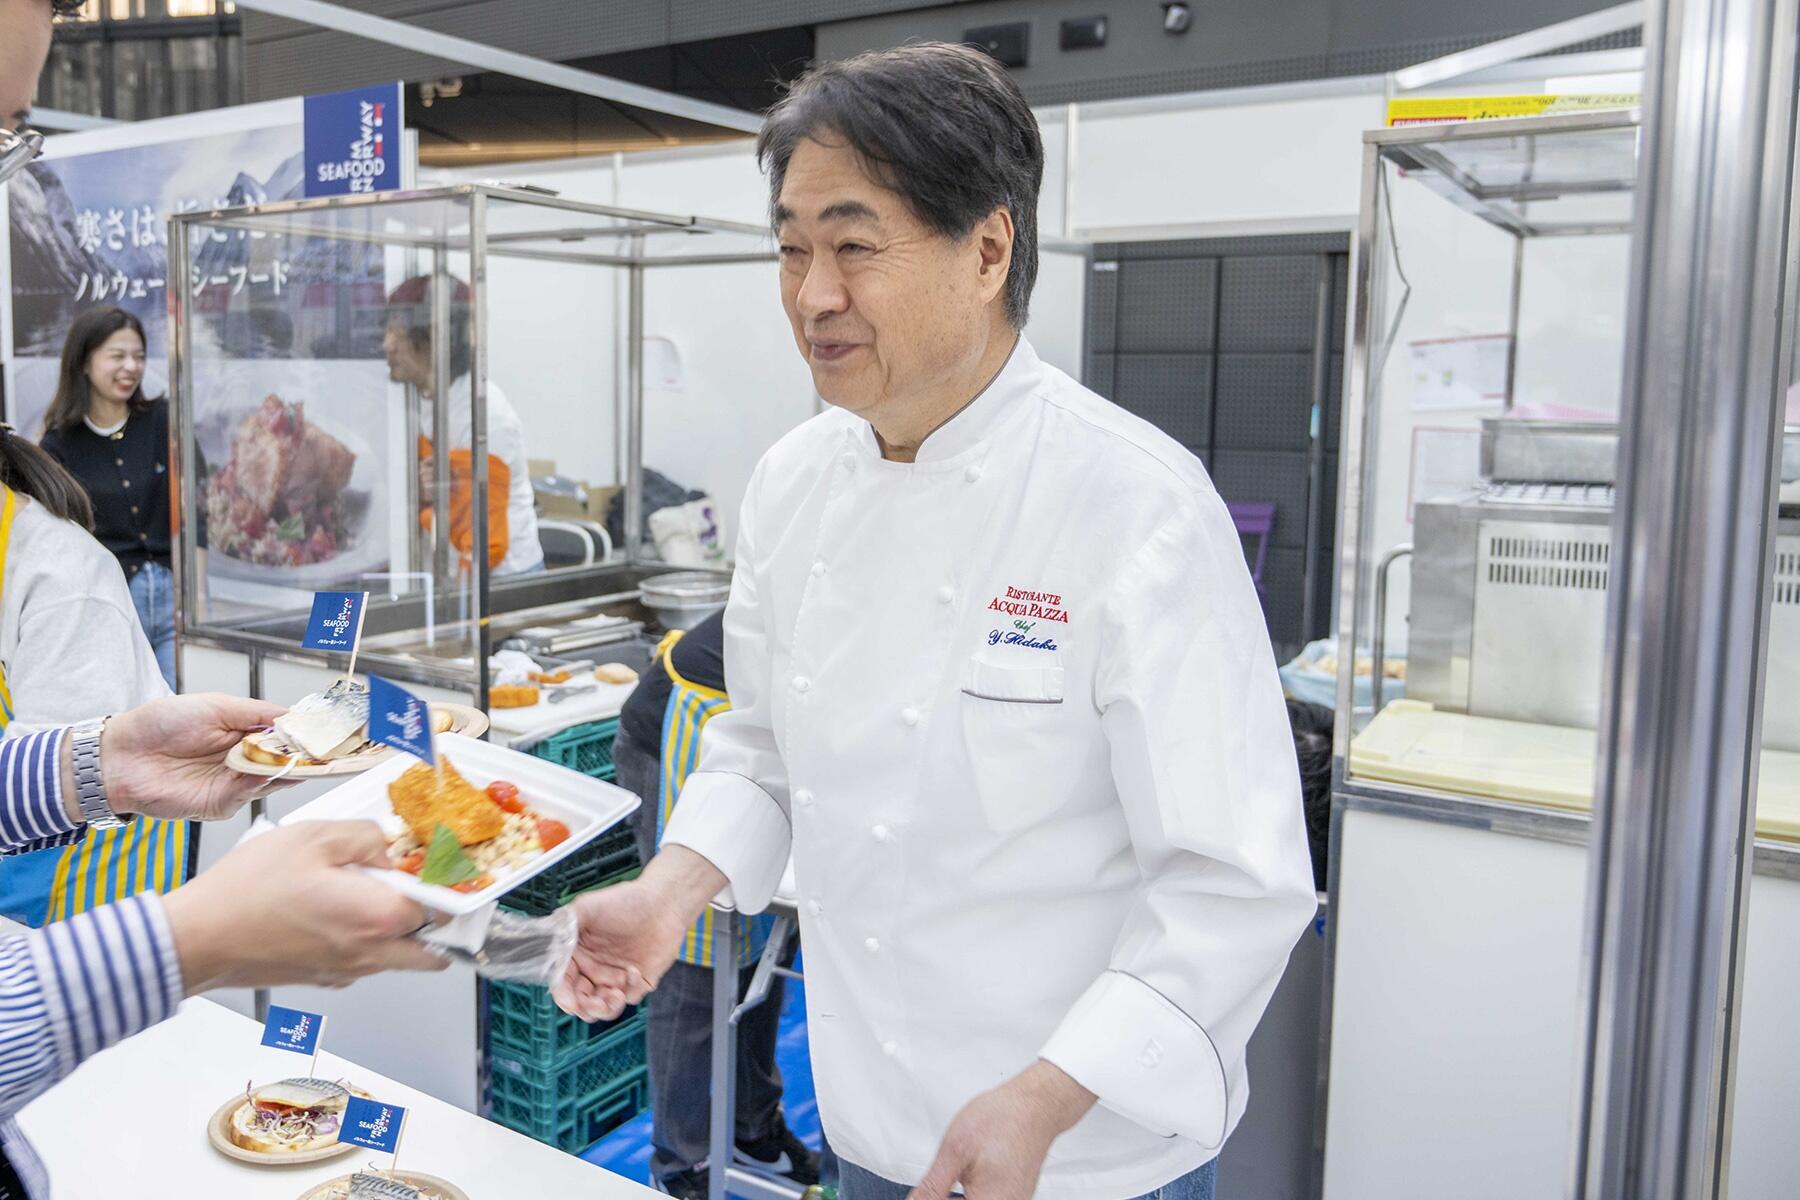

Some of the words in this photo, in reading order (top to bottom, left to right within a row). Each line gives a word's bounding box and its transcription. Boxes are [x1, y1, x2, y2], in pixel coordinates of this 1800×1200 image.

[317, 157, 385, 182] SEAFOOD
[988, 597, 1028, 616] ACQUA
[1028, 603, 1069, 623] PAZZA
[323, 619, 350, 628] SEAFOOD
[358, 1120, 388, 1133] SEAFOOD
